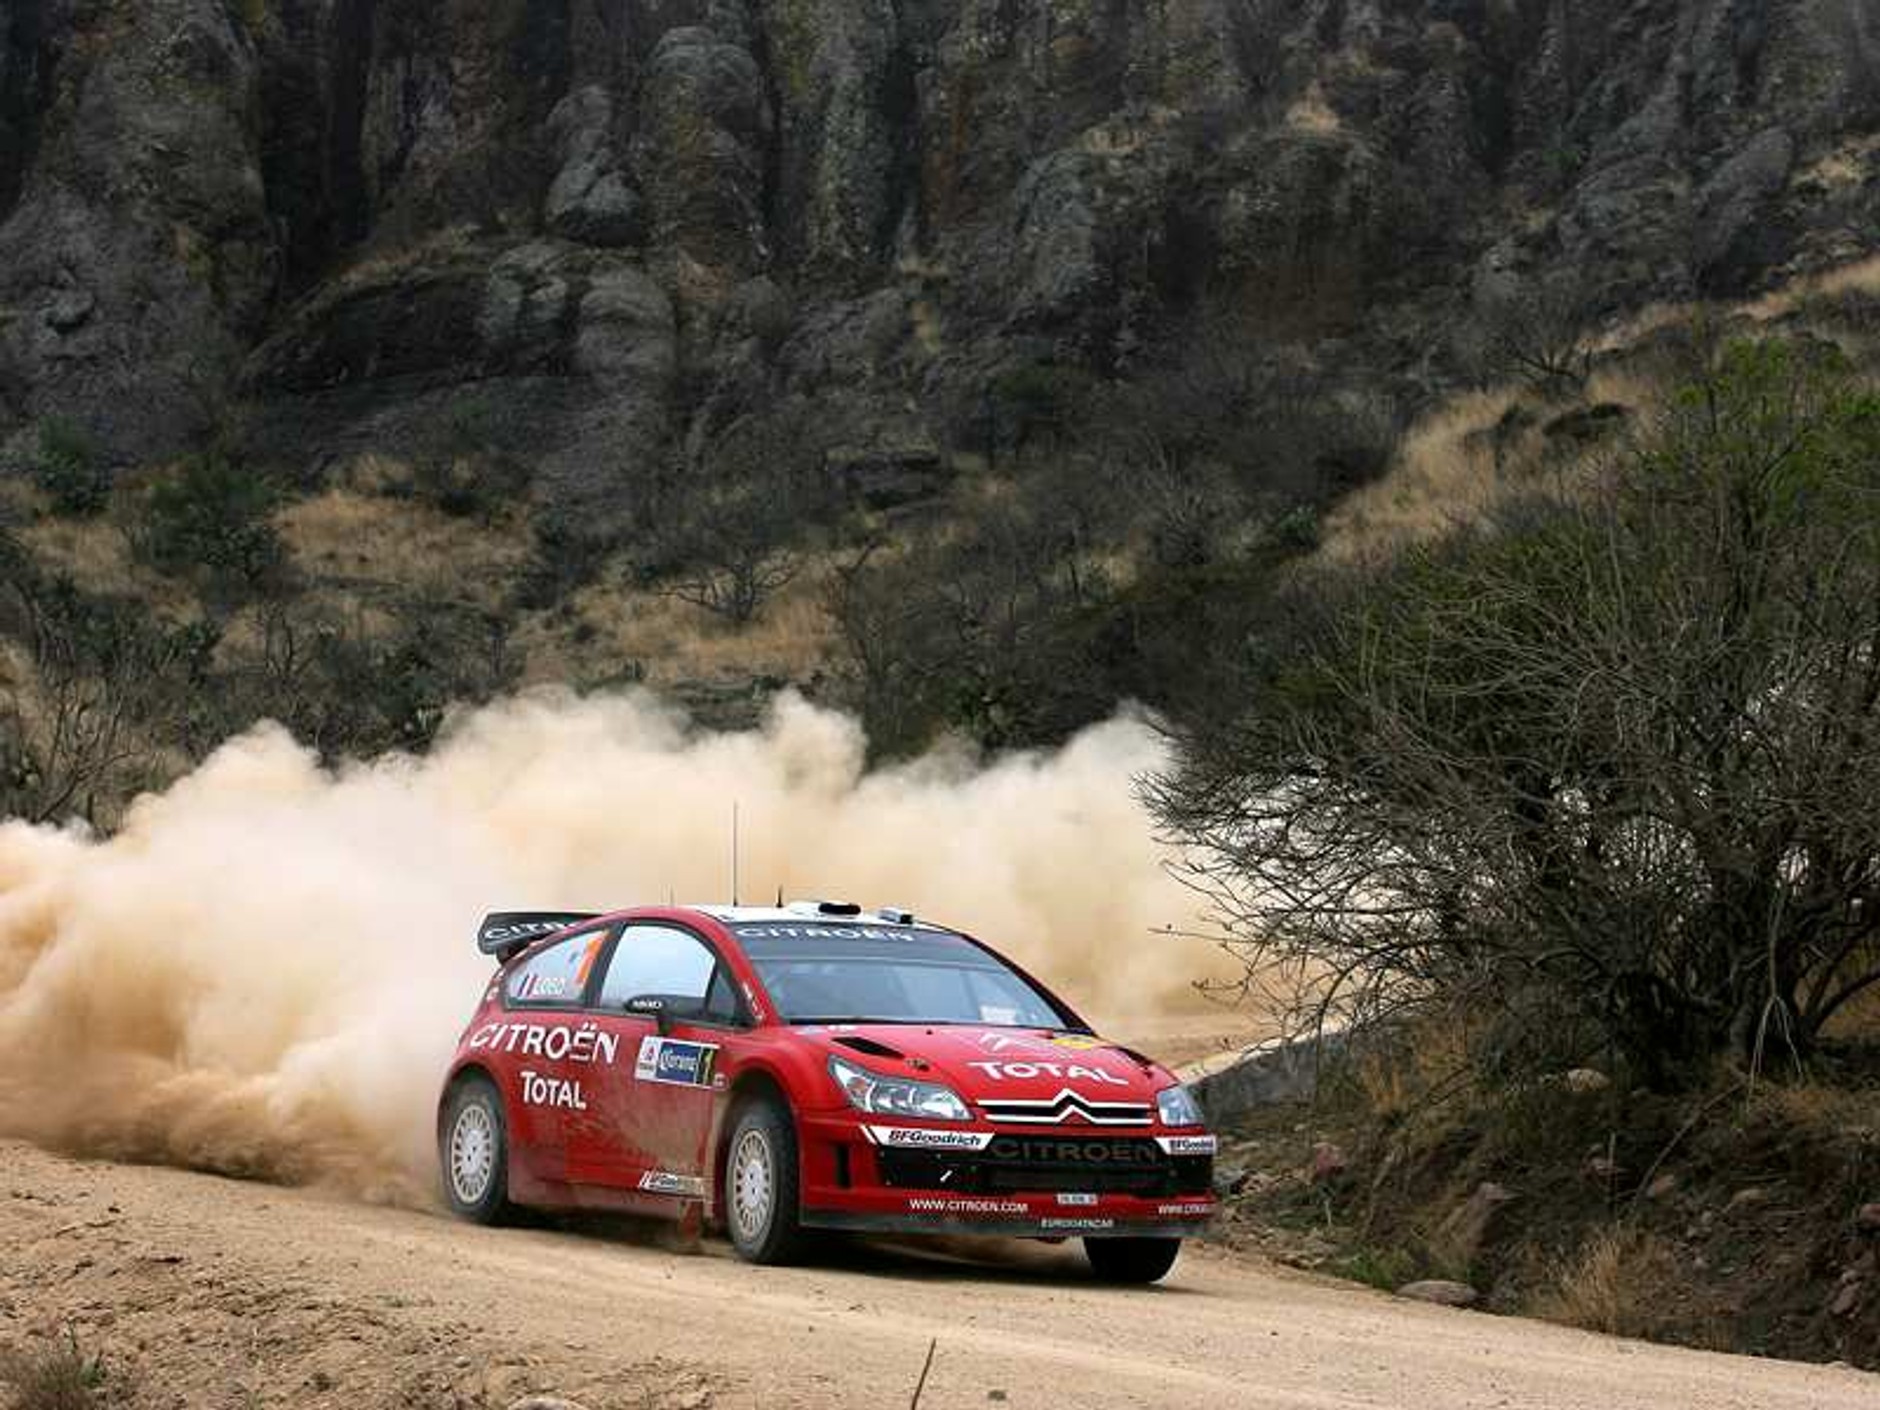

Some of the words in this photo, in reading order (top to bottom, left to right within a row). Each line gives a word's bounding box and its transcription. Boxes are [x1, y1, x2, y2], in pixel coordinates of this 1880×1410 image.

[967, 1061, 1130, 1086] TOTAL
[519, 1070, 587, 1111] TOTAL
[888, 1129, 982, 1146] BFGoodrich
[908, 1198, 1029, 1214] WWW.CITROEN.COM
